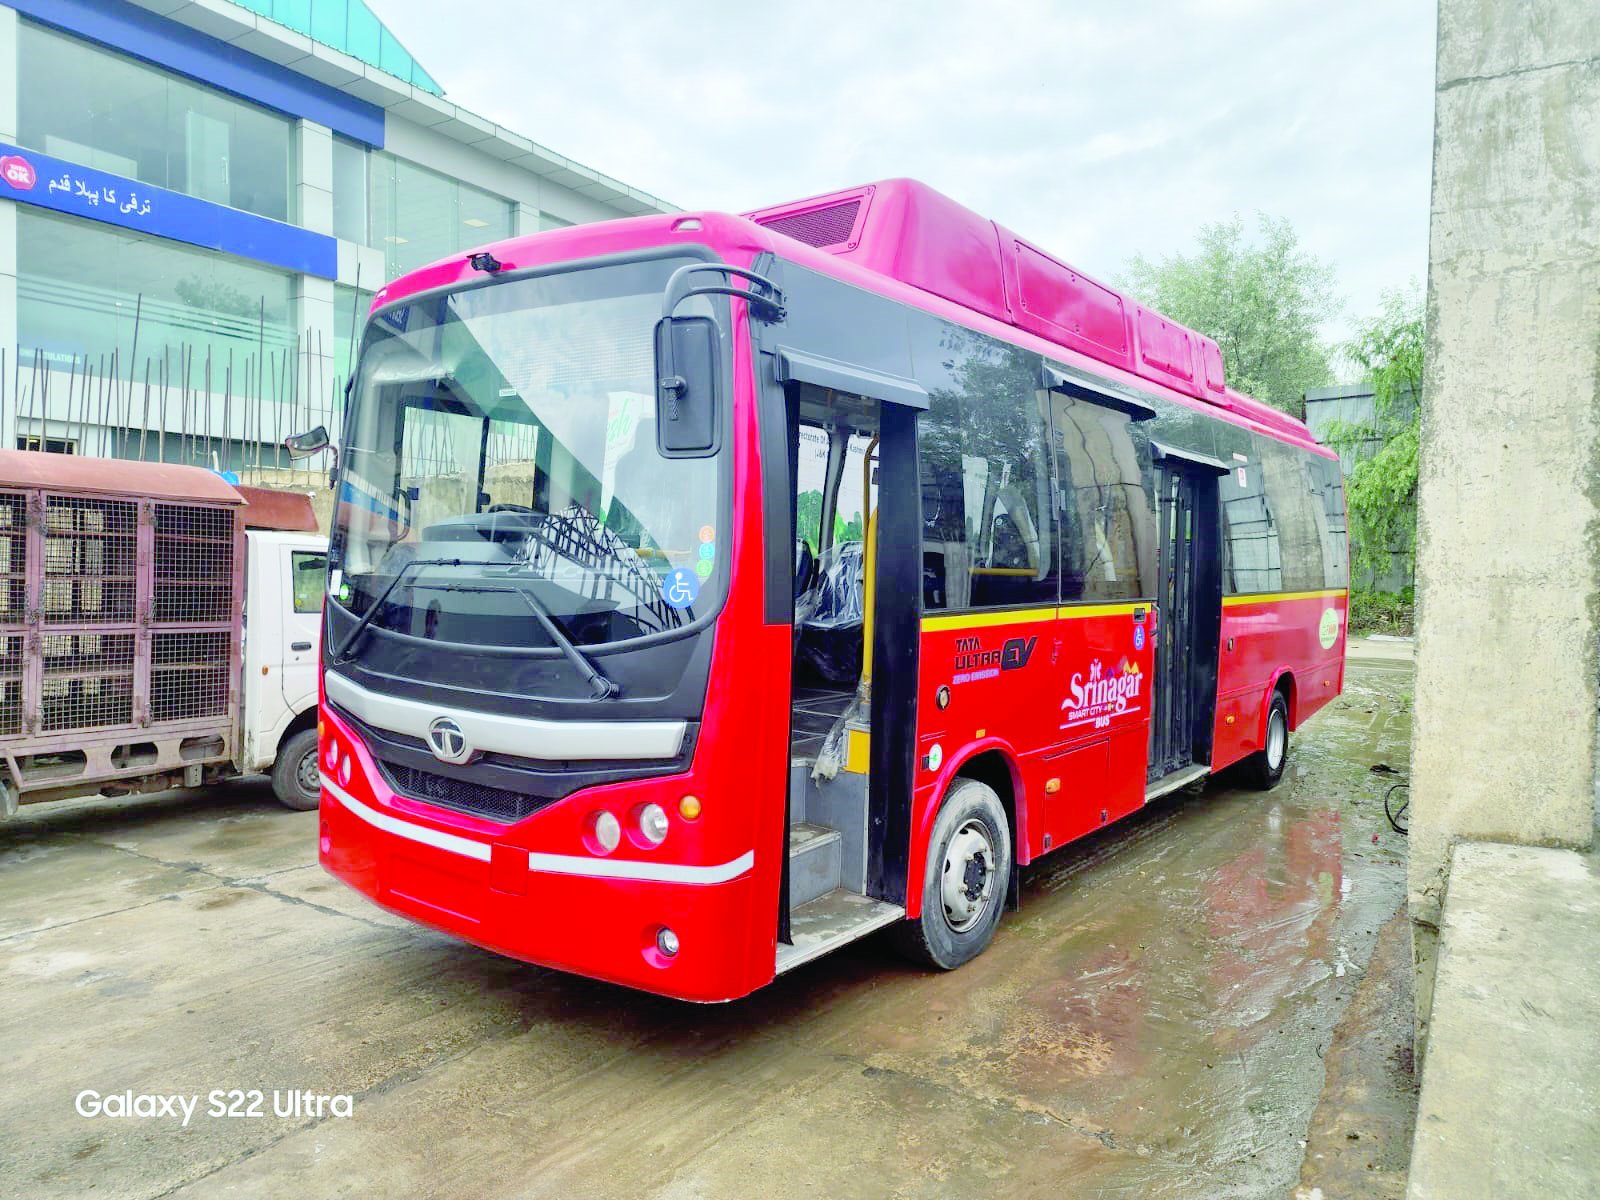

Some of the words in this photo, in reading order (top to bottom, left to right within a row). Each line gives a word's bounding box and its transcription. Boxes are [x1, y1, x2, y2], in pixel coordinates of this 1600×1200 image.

[7, 169, 31, 184] OK
[48, 175, 71, 194] قدم
[74, 179, 99, 206] پہلا
[103, 187, 116, 204] کا
[120, 193, 151, 215] ترقی
[955, 650, 1001, 670] ULTRA
[1001, 636, 1038, 671] EV
[956, 637, 981, 652] TATA
[1061, 670, 1143, 713] Srinagar
[1068, 708, 1089, 720] SMART
[1089, 705, 1102, 716] CITY
[1095, 715, 1110, 728] BUS
